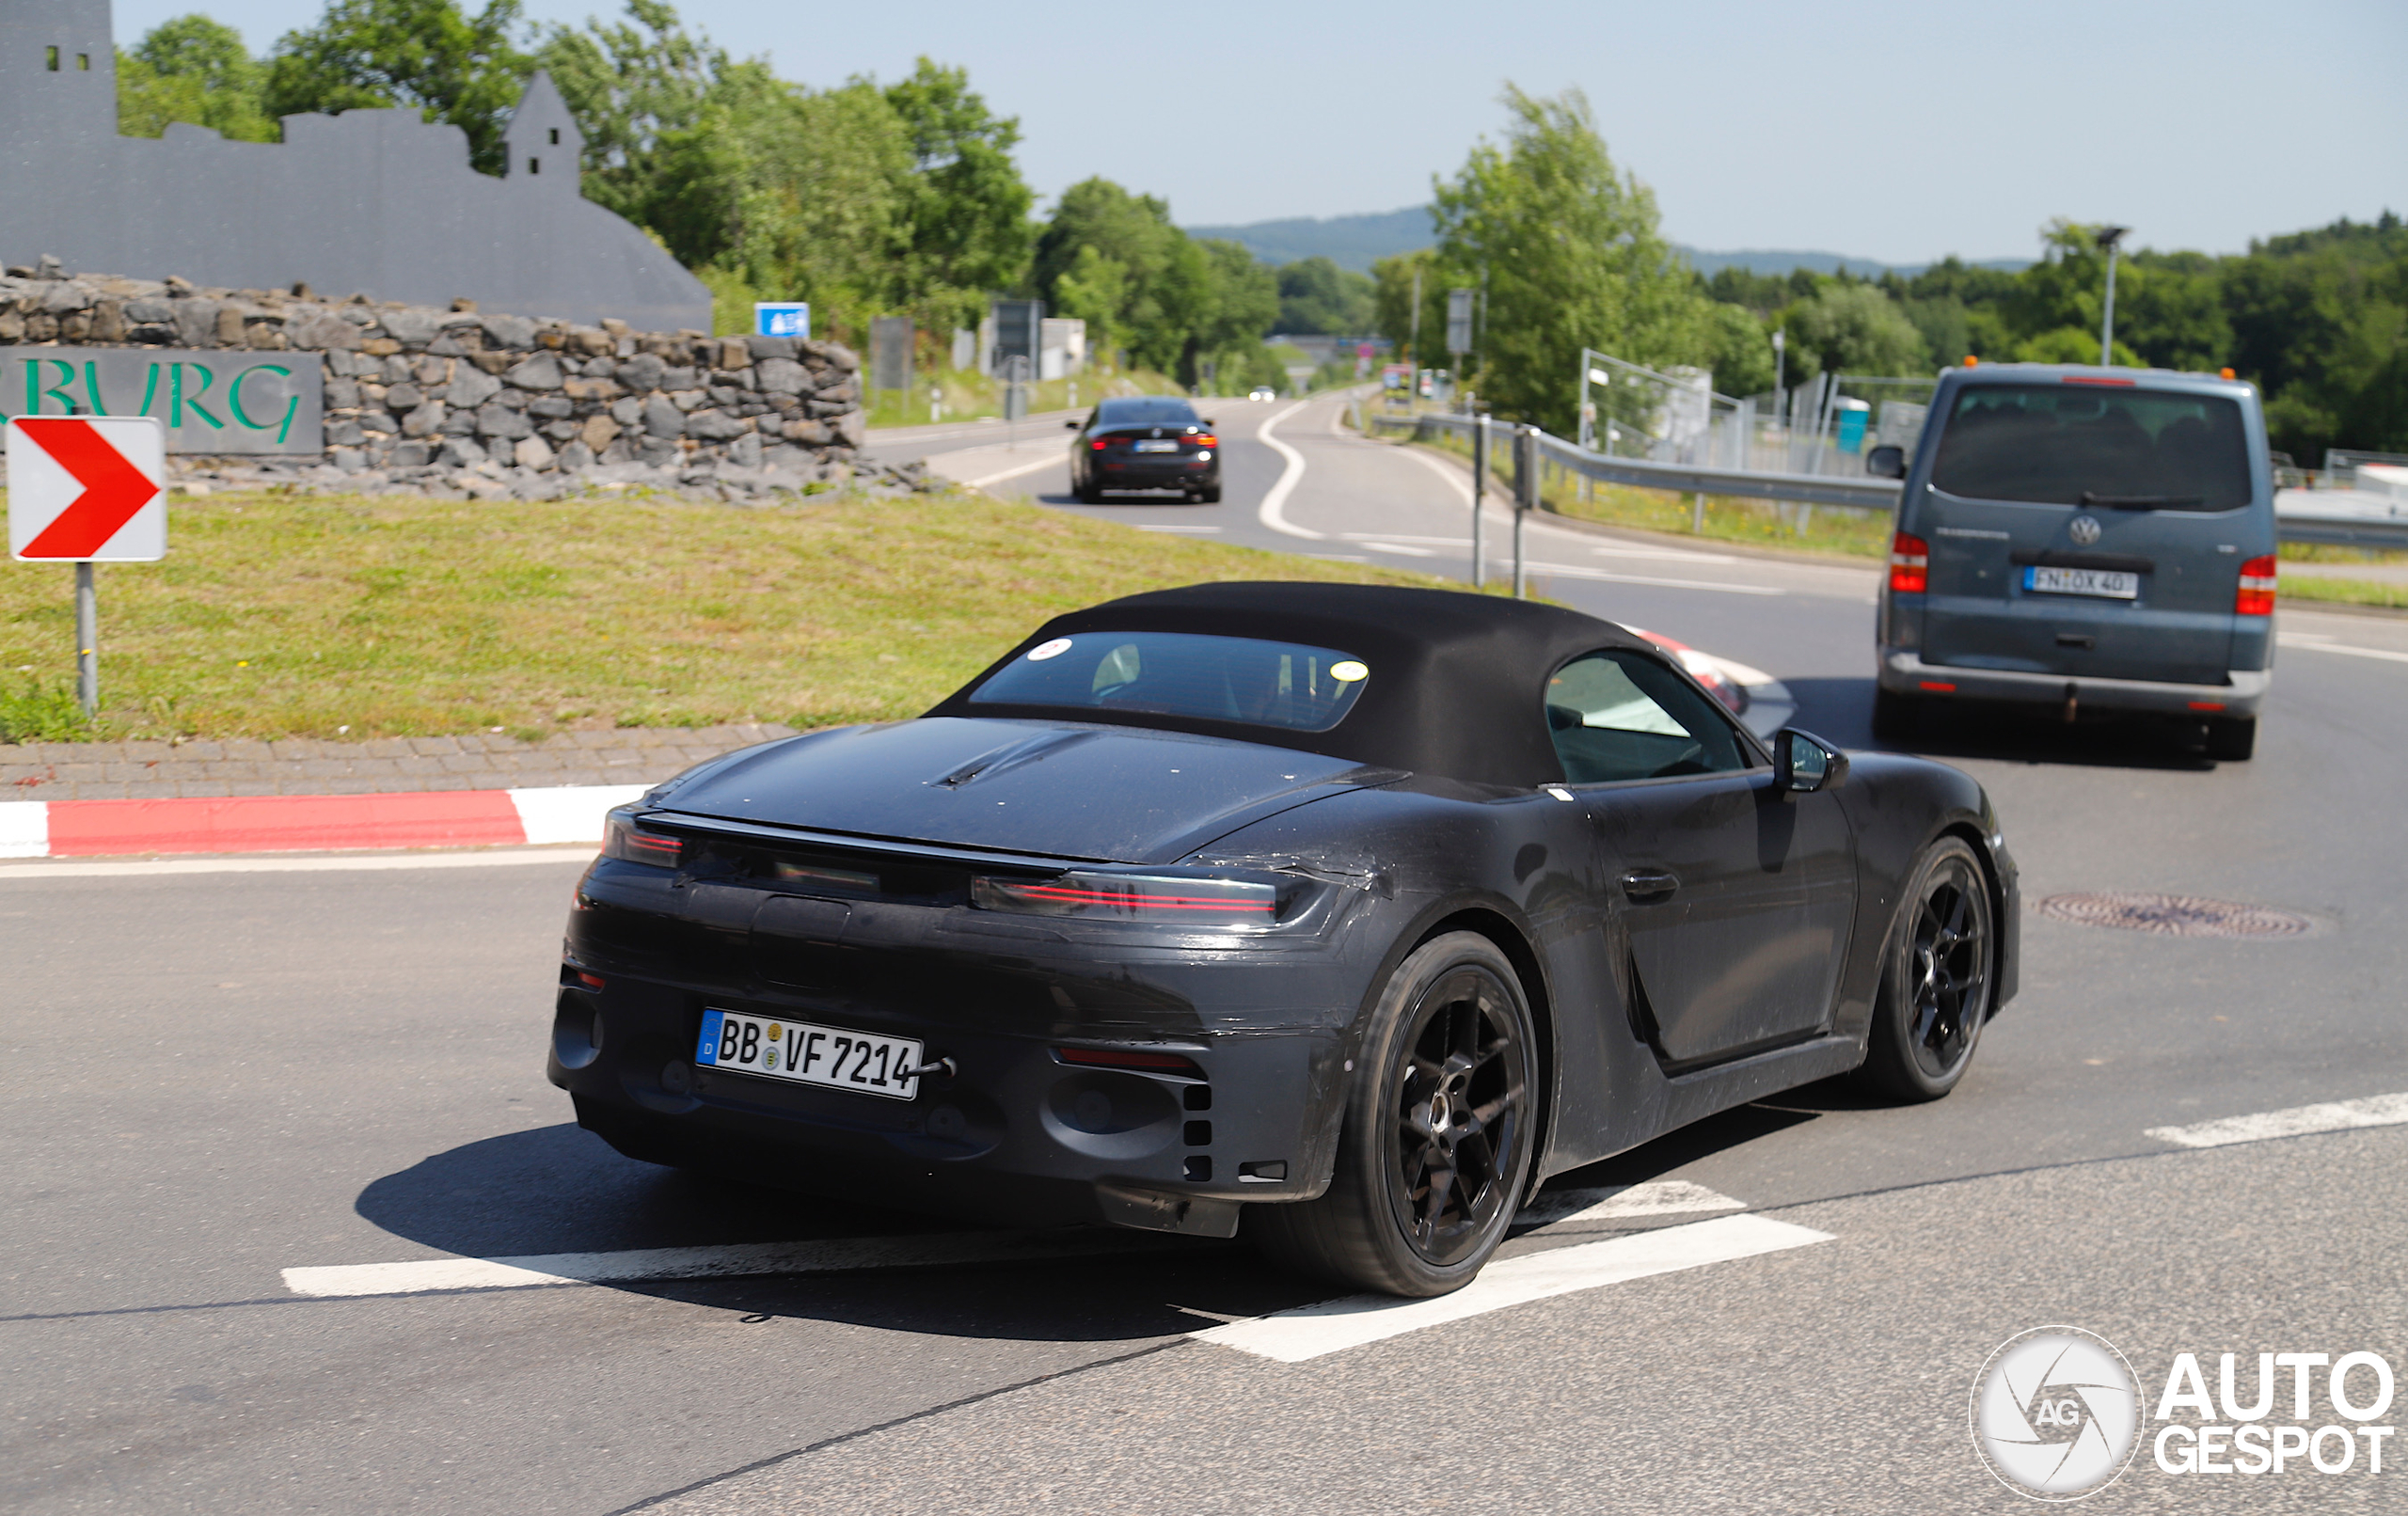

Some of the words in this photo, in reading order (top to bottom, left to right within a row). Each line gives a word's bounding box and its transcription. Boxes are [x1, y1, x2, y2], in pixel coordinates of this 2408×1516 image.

[0, 357, 299, 444] BURG
[704, 1043, 713, 1055] D
[719, 1019, 760, 1064] BB
[785, 1029, 826, 1074] VF
[831, 1036, 910, 1090] 7214
